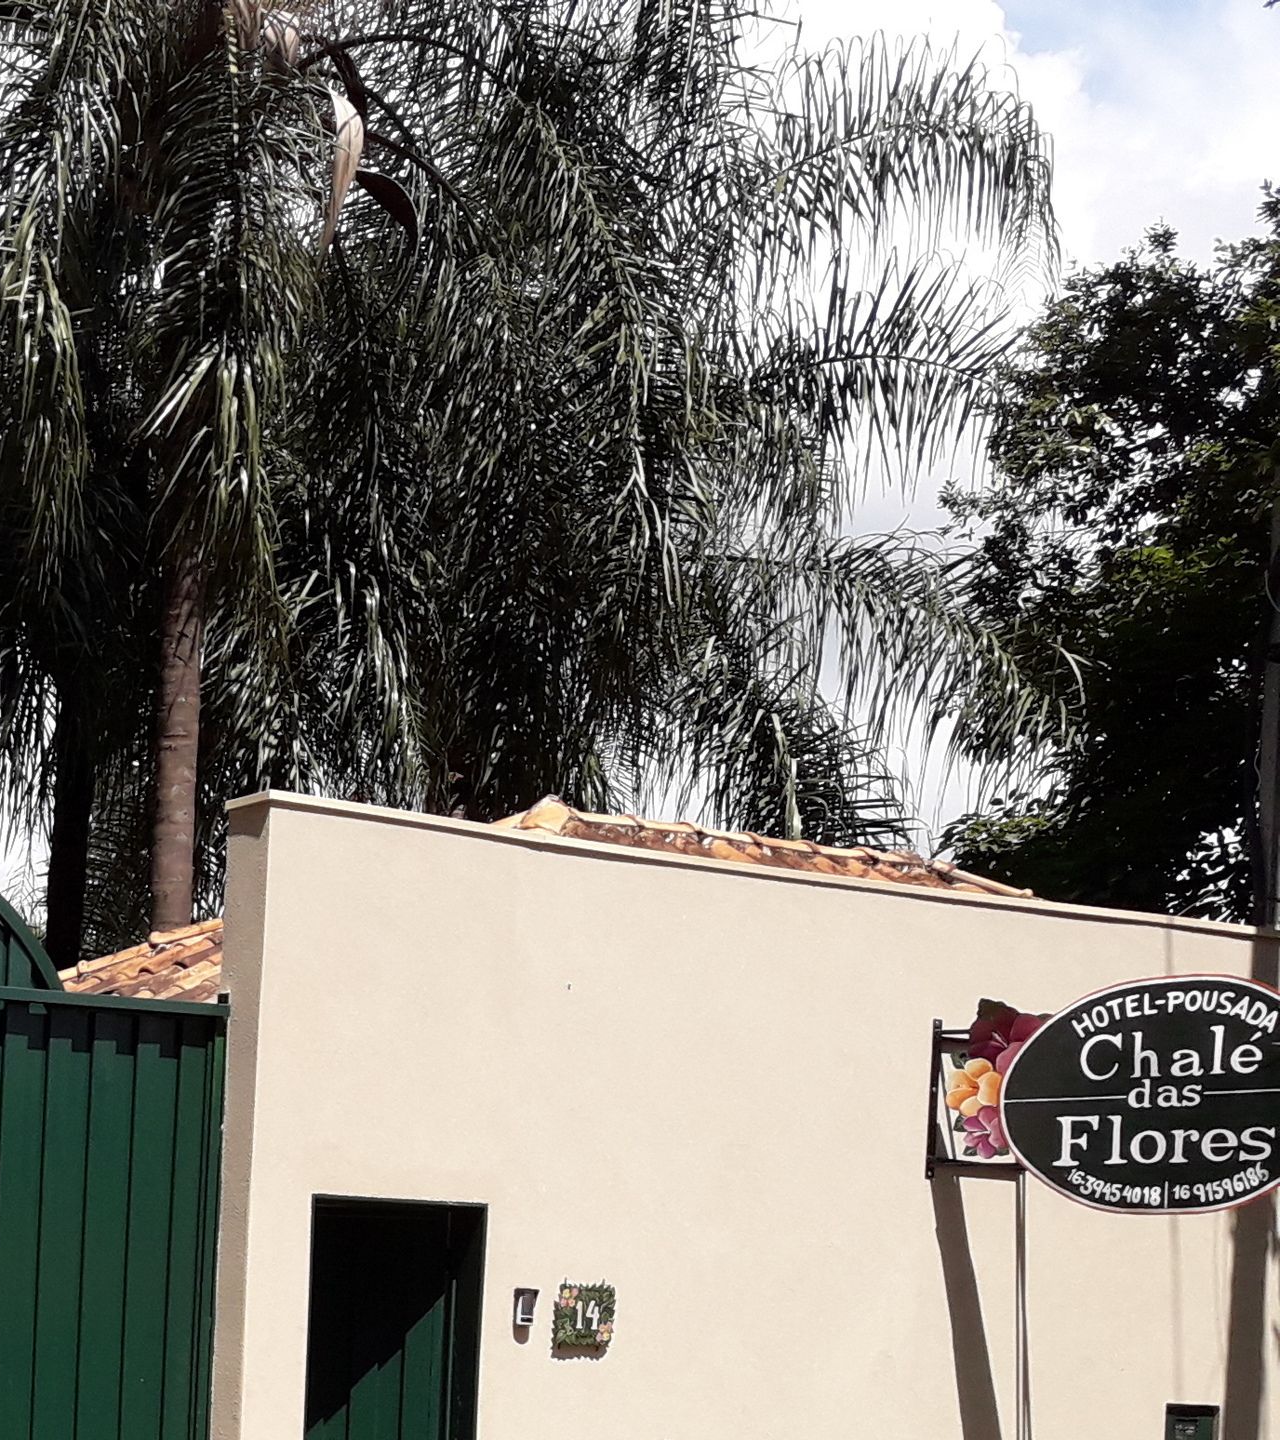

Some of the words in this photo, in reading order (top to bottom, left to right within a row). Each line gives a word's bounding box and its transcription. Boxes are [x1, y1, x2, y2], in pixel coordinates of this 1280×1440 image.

[1080, 1025, 1263, 1080] Chalé
[1127, 1079, 1202, 1108] das
[1052, 1115, 1276, 1167] Flores
[575, 1300, 600, 1331] 14
